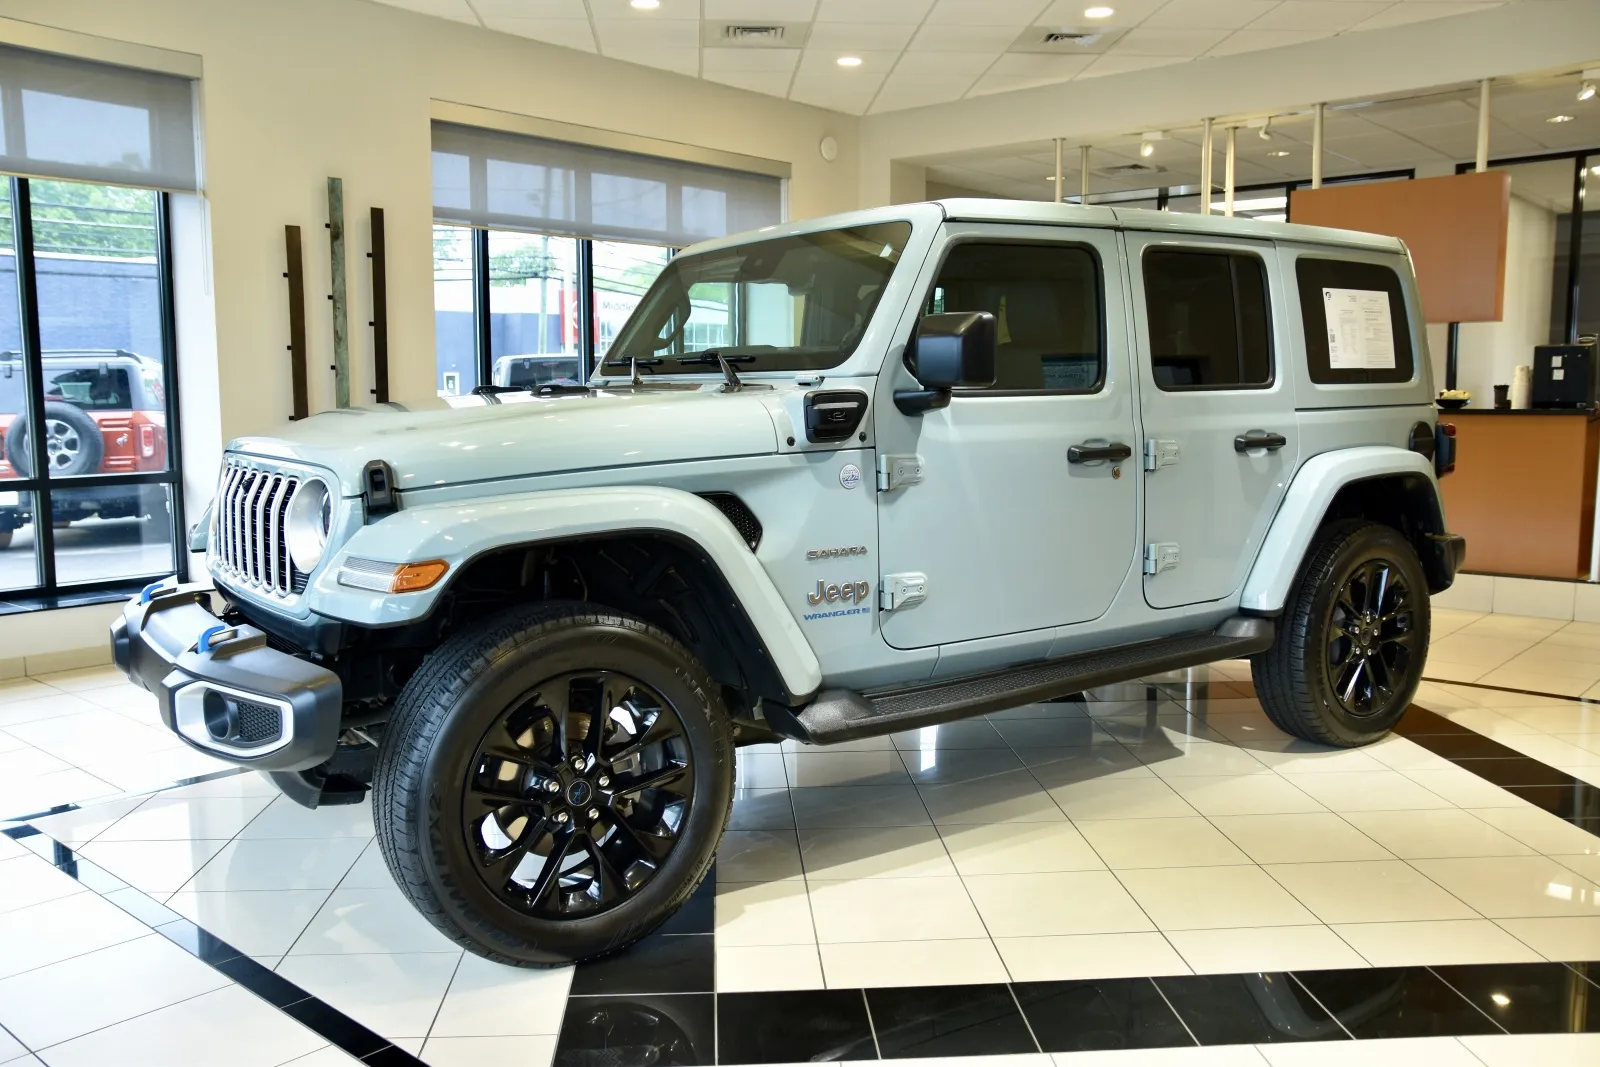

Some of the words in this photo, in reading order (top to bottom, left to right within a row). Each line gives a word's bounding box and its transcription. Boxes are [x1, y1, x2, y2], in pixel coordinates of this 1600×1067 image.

[806, 545, 868, 560] SAHARA
[808, 579, 870, 605] Jeep
[803, 608, 861, 621] WRANGLER
